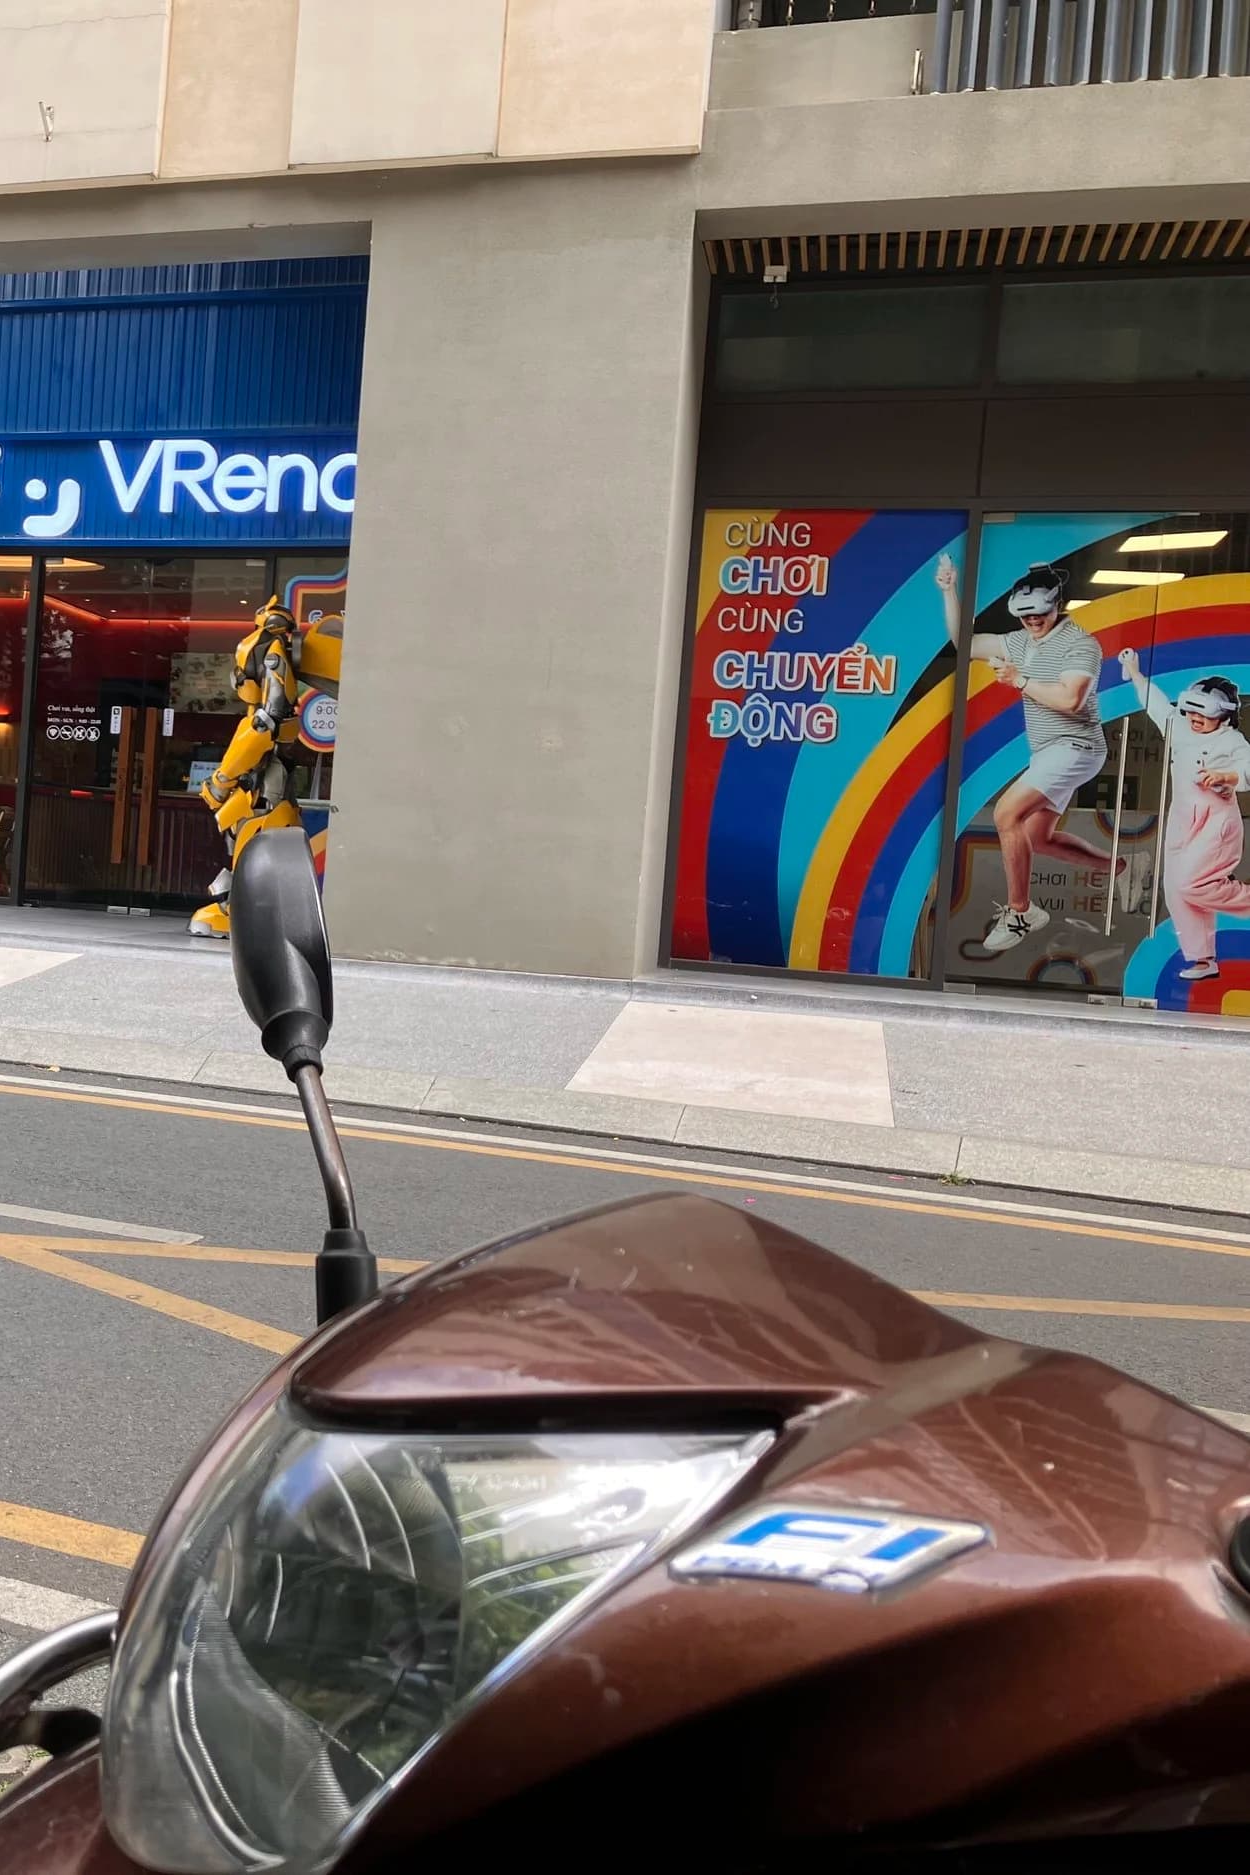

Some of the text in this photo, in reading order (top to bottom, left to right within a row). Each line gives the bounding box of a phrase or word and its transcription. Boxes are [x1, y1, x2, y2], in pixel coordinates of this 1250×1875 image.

[724, 516, 812, 548] CÙNG
[718, 554, 829, 596] CHƠI
[717, 602, 805, 634] CÙNG
[713, 642, 898, 695] CHUYỂN
[312, 719, 335, 729] 22:0
[707, 692, 838, 748] ĐỘNG
